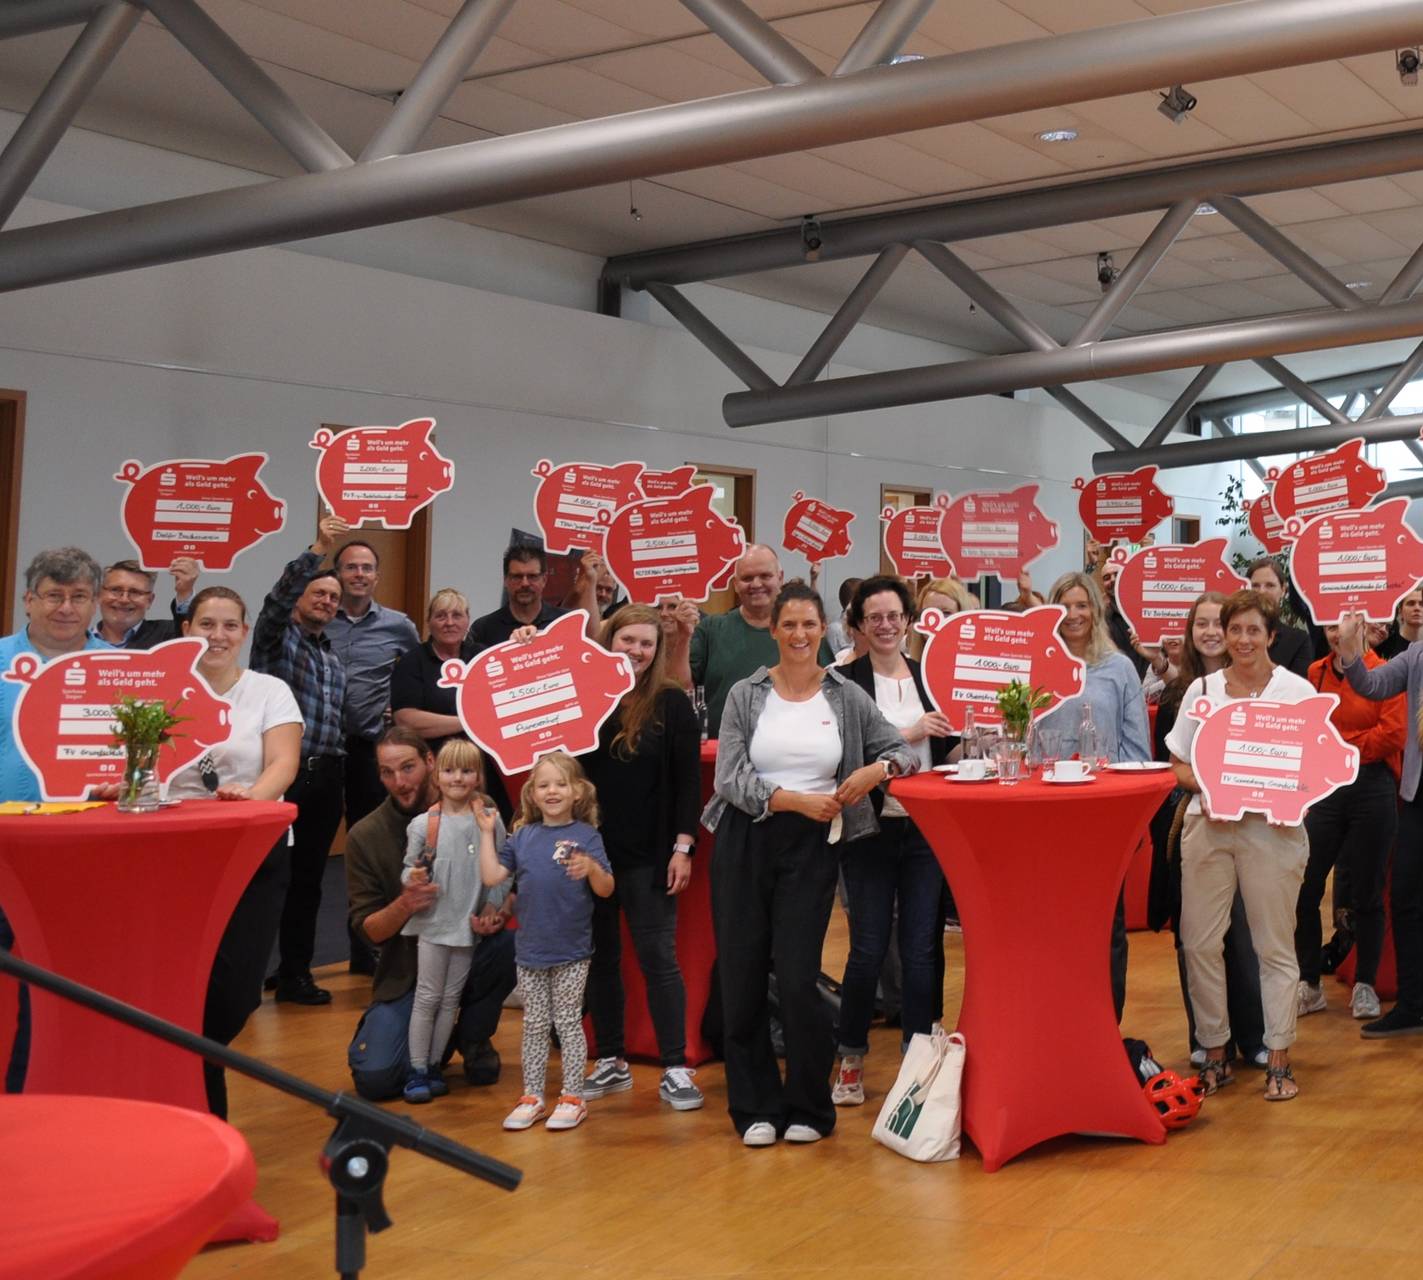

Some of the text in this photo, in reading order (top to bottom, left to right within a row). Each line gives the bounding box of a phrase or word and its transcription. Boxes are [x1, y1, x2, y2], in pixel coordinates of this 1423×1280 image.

[984, 626, 1003, 635] Weil's
[1010, 636, 1028, 645] geht.
[510, 644, 564, 664] Weil's um mehr
[512, 653, 560, 671] als Geld geht.
[1002, 662, 1020, 670] Euro
[98, 668, 123, 677] Weil's
[141, 669, 165, 678] mehr
[97, 678, 156, 688] als Geld geht.
[1281, 723, 1299, 732] geht.
